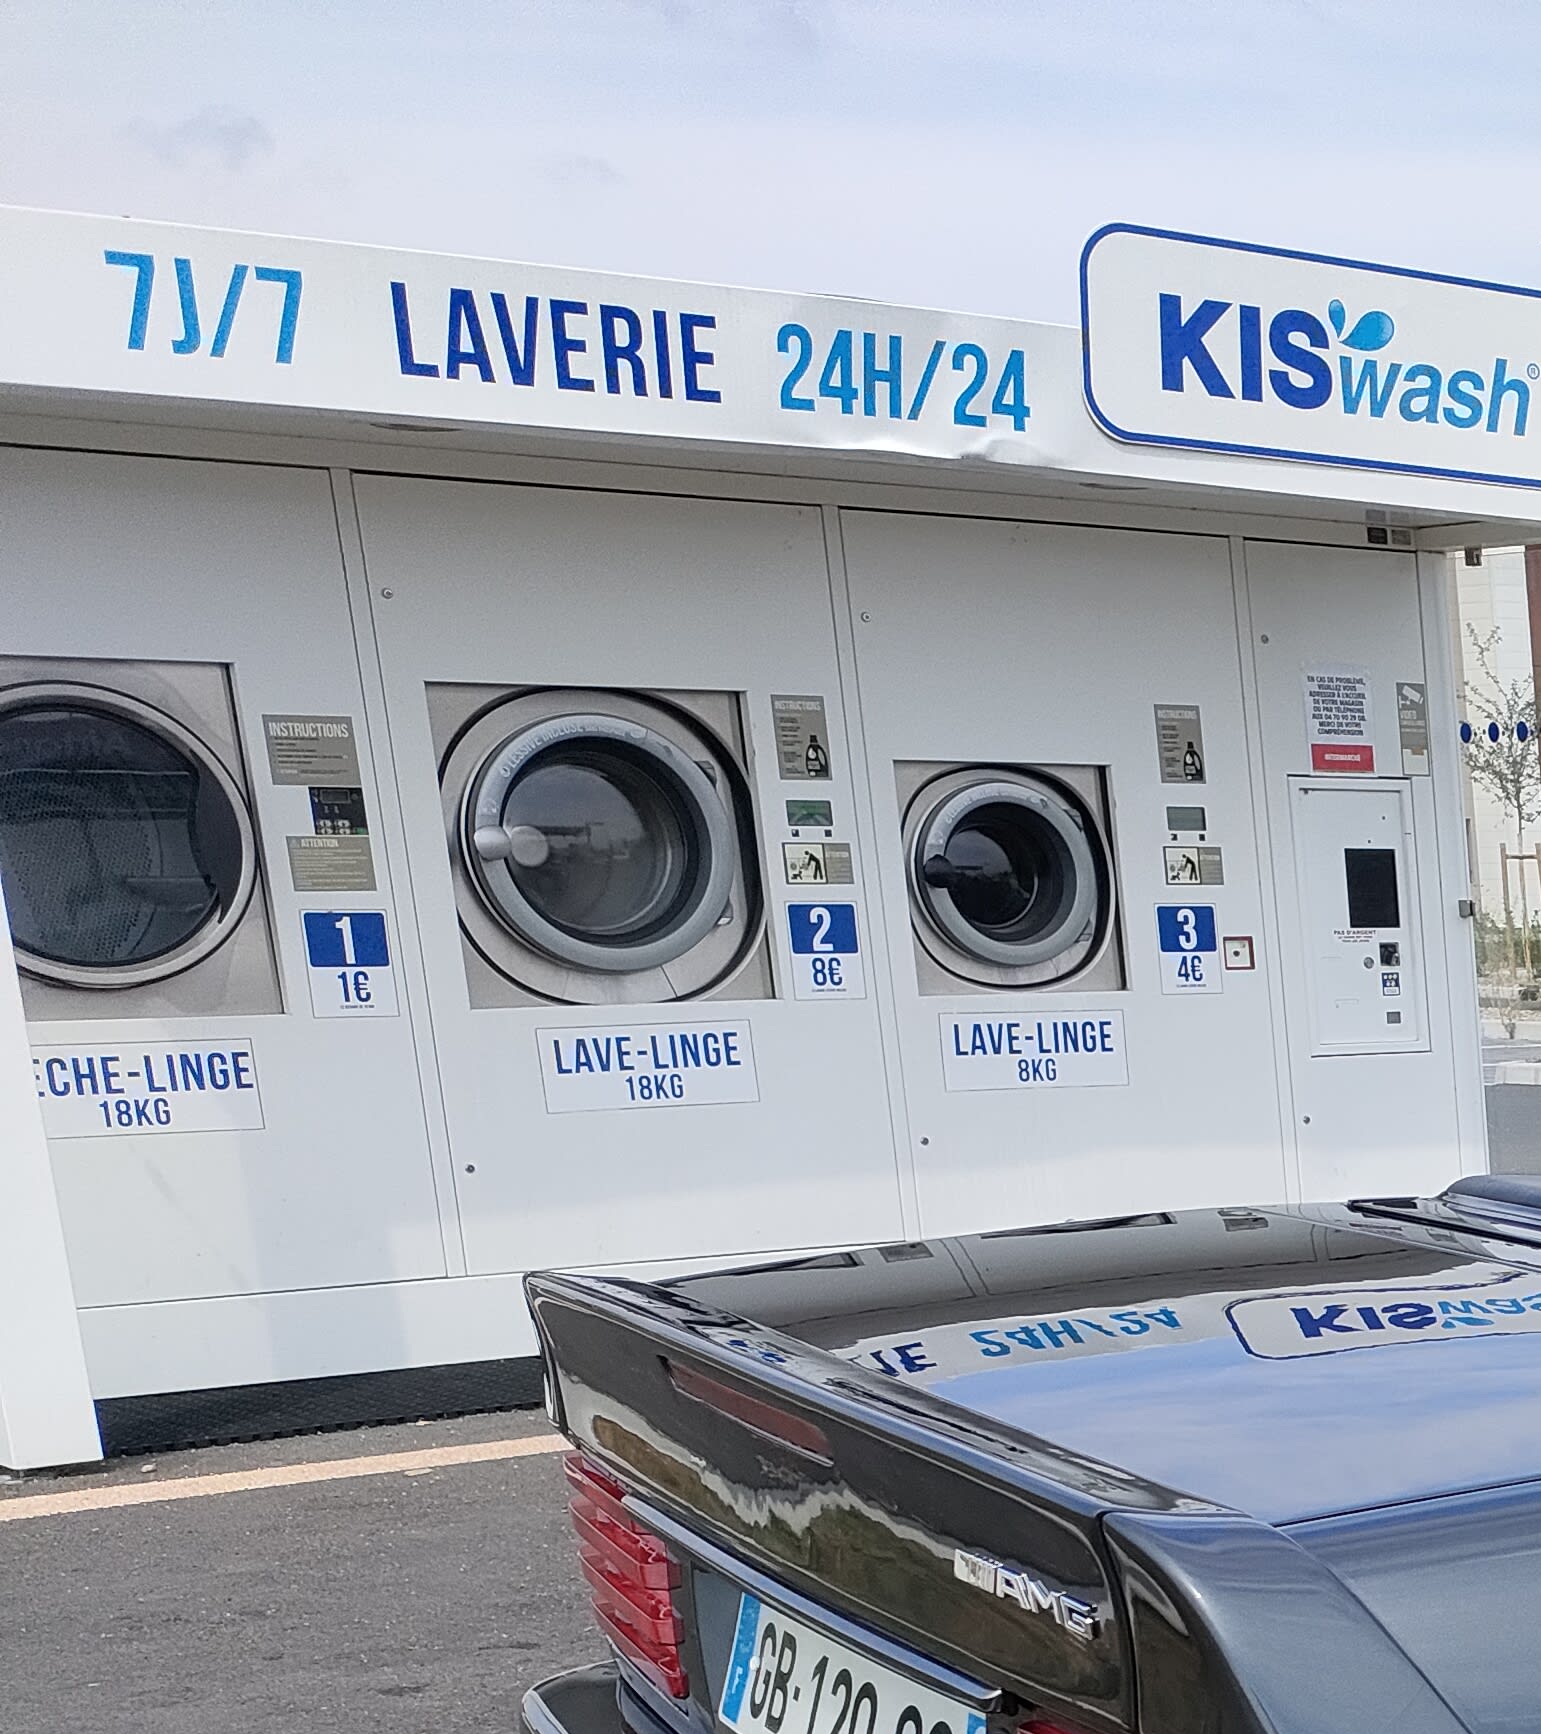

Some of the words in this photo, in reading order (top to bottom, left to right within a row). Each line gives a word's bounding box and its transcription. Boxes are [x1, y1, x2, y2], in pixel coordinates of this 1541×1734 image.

[104, 250, 303, 365] 7J/7
[390, 281, 722, 405] LAVERIE
[776, 323, 1031, 433] 24H/24
[268, 722, 349, 738] INSTRUCTIONS
[335, 916, 356, 965] 1
[809, 906, 834, 952] 2
[1176, 908, 1198, 951] 3
[811, 957, 843, 986] 8€
[1178, 955, 1203, 983] 4€
[337, 971, 372, 1003] 1€
[552, 1032, 742, 1075] LAVE-LINGE
[953, 1020, 1115, 1057] LAVE-LINGE
[624, 1073, 684, 1101] 18KG
[1017, 1058, 1057, 1082] 8KG
[99, 1097, 171, 1128] 18KG
[996, 1561, 1099, 1641] AMG
